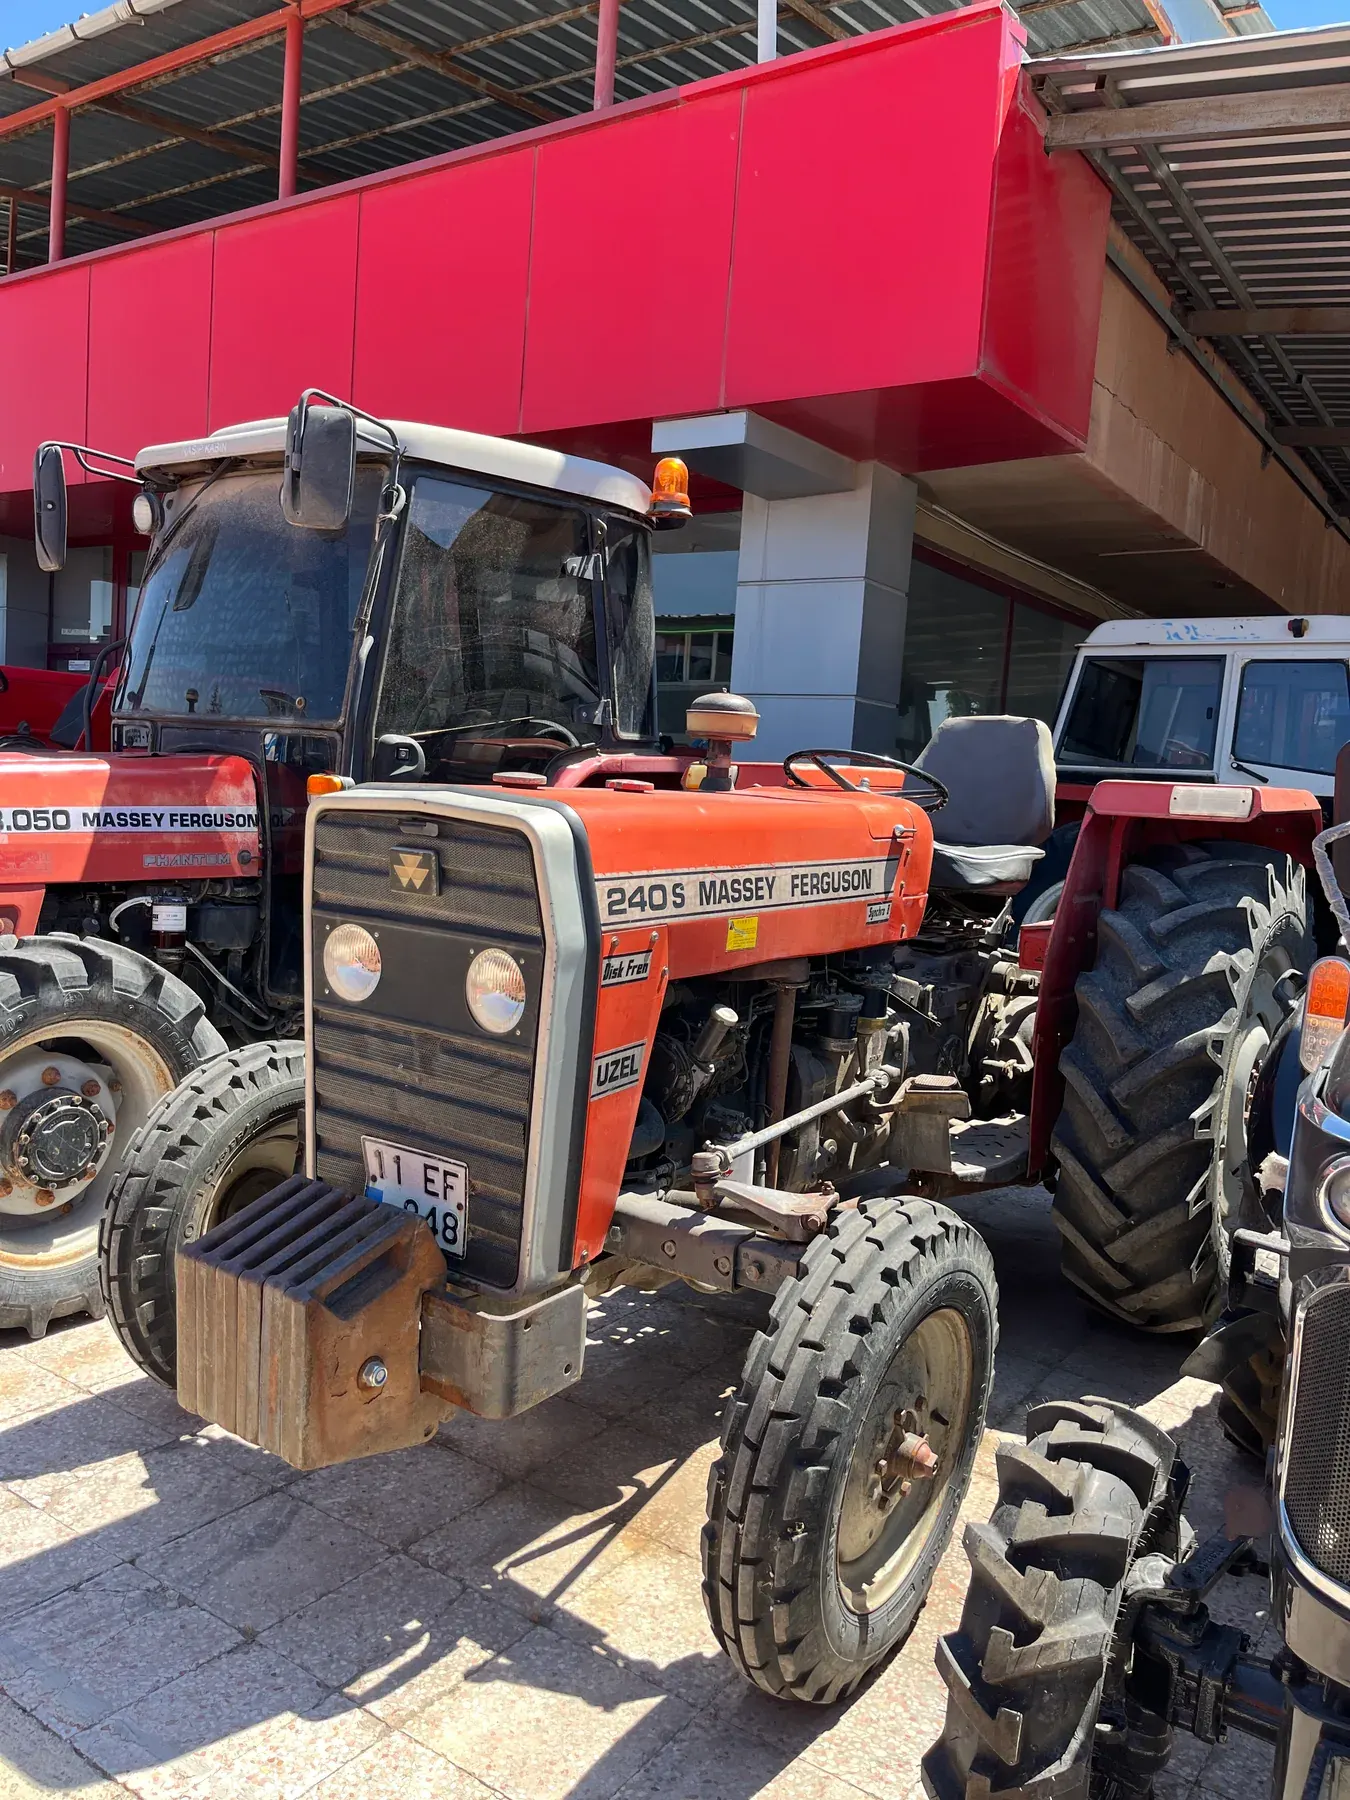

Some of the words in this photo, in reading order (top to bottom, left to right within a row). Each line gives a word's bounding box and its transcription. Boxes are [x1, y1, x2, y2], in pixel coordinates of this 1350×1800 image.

[0, 809, 71, 831] .050
[82, 812, 164, 828] MASSEY
[169, 813, 258, 828] FERGUSON
[143, 853, 231, 867] PHANTOM
[698, 875, 776, 906] MASSEY
[791, 868, 872, 897] FERGUSON
[602, 960, 624, 981] Disk
[625, 959, 649, 977] Fren
[596, 1053, 638, 1087] UZEL
[374, 1149, 402, 1185] 11
[423, 1162, 459, 1200] EF
